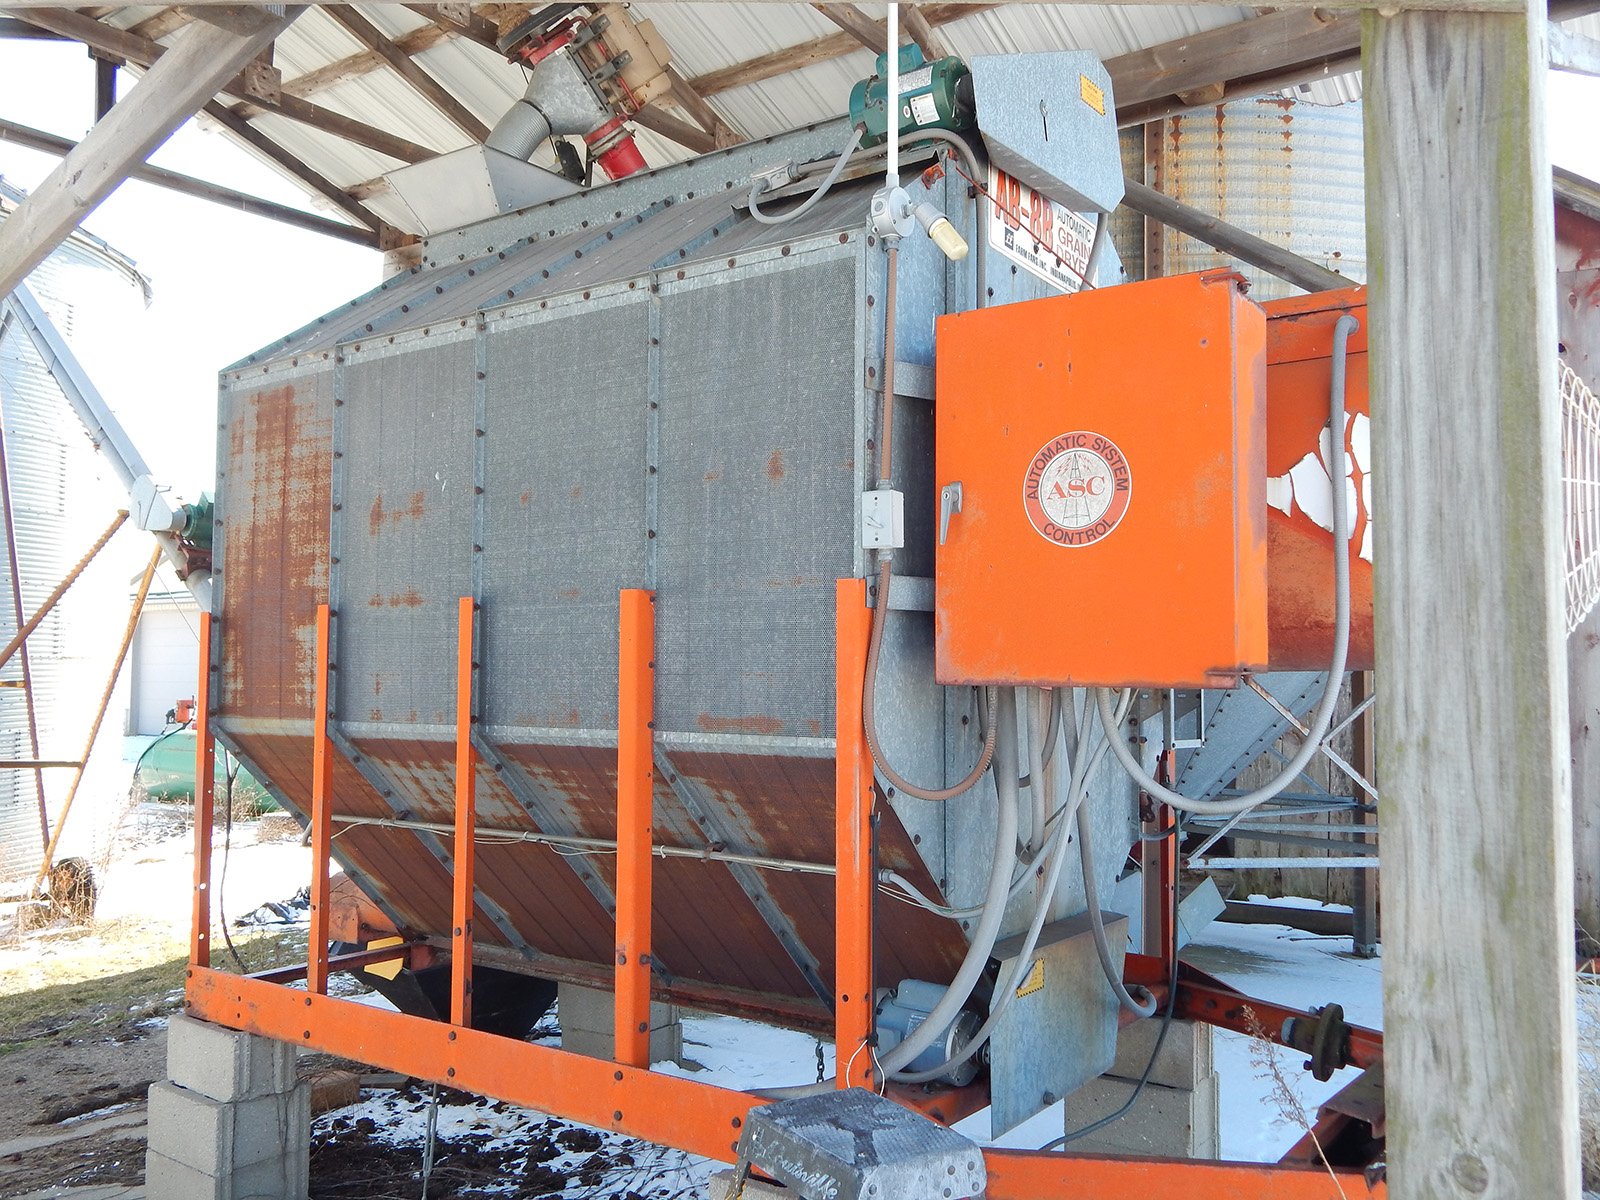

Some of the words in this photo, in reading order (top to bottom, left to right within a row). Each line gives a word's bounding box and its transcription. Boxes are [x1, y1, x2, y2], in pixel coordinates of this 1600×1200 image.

[1057, 208, 1092, 243] AUTOMATIC
[1058, 227, 1091, 260] GRAIN
[1056, 244, 1086, 276] DRYE
[1027, 434, 1088, 500] AUTOMATIC
[1092, 437, 1129, 491] SYSTEM
[1047, 475, 1106, 501] ASC
[1043, 519, 1116, 545] CONTROL
